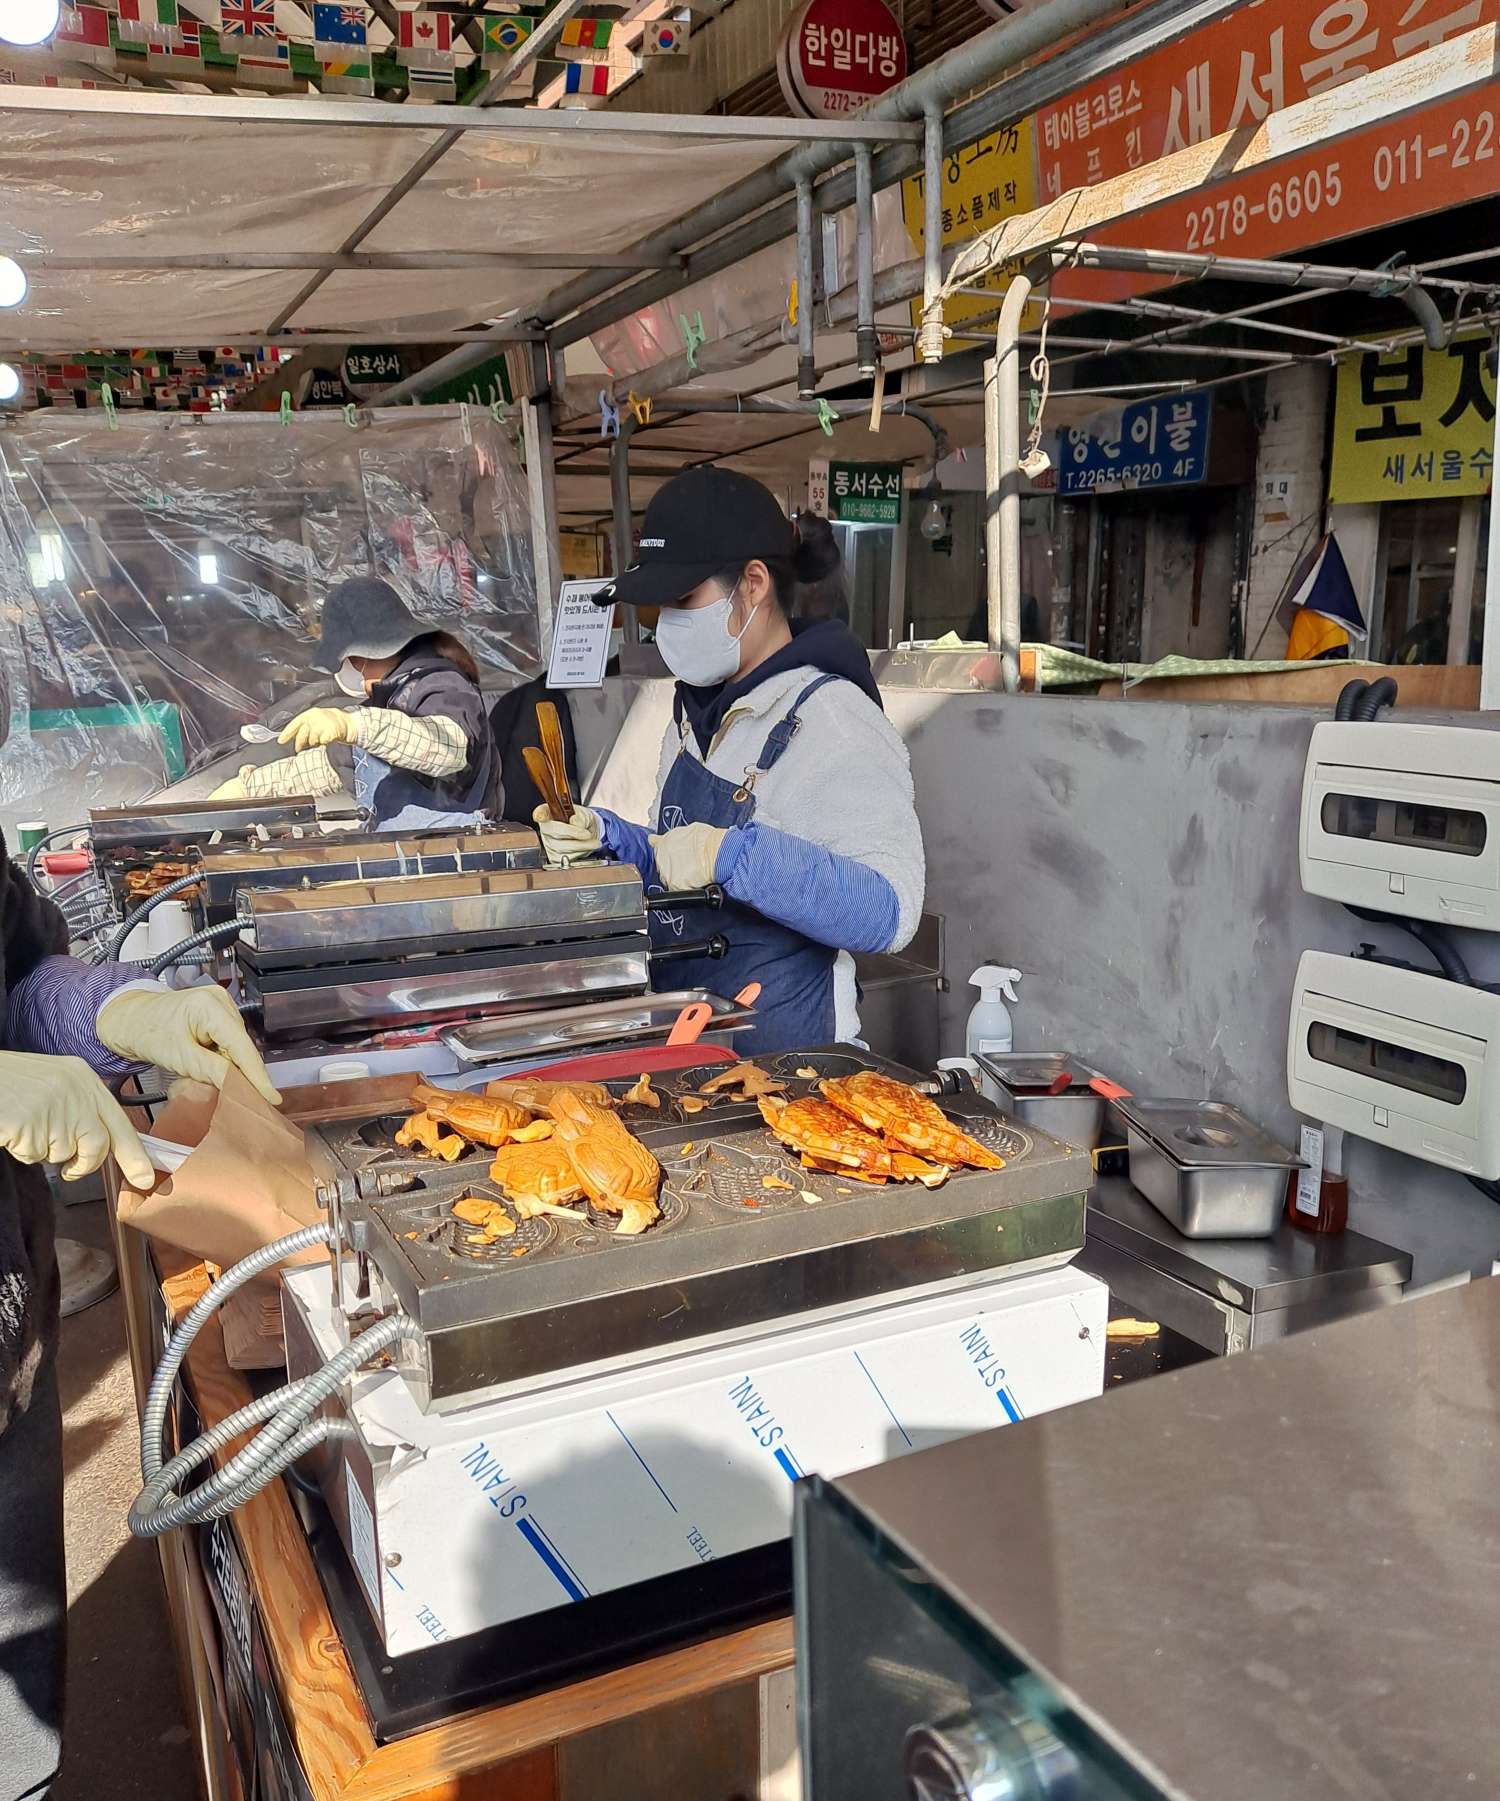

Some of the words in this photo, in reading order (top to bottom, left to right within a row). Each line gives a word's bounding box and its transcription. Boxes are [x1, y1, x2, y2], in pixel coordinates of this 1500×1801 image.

[804, 22, 900, 78] 한일다방
[823, 91, 869, 112] 2272-2
[1044, 79, 1143, 151] 테이블크로스
[1186, 163, 1342, 250] 2278-6605
[1373, 110, 1500, 193] 011-22
[922, 179, 1018, 235] 종소품제작
[346, 354, 400, 375] 일호상사
[833, 470, 900, 498] 동서수선
[1065, 462, 1162, 489] T.2265-6320
[1172, 457, 1196, 478] 4F
